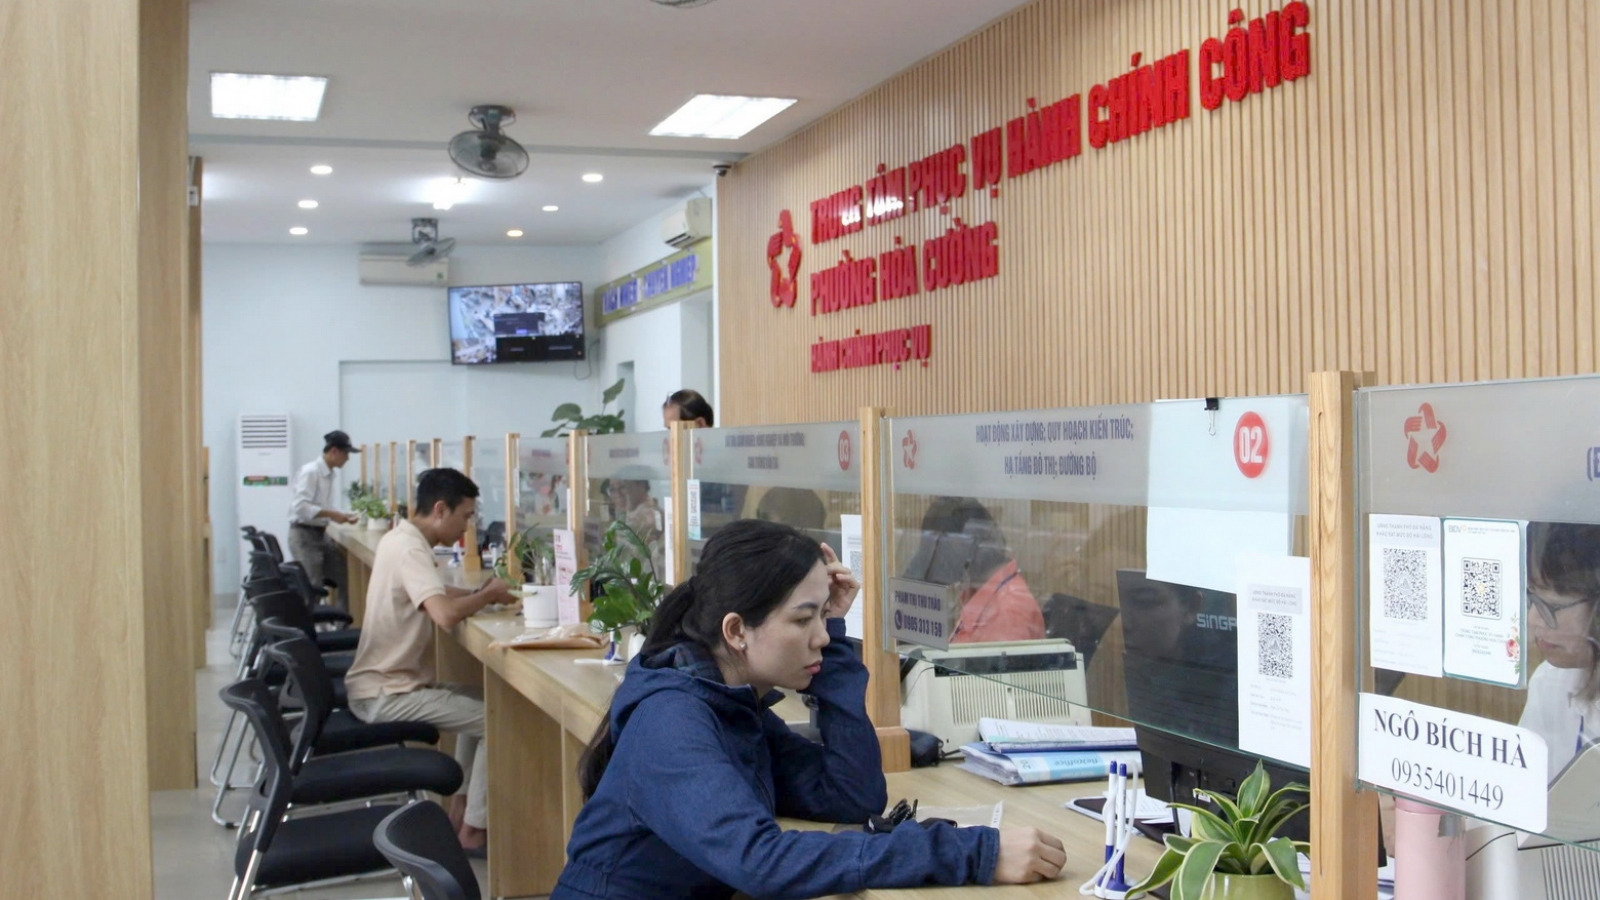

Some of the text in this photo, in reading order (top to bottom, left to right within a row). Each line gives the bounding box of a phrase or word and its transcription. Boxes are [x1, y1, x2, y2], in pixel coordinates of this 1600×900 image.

[810, 0, 1310, 245] TRUNG TÂM PHỤC VỤ HÀNH CHÍNH CÔNG
[810, 217, 999, 316] PHƯỜNG HÒA CƯỜNG
[975, 425, 992, 447] HOẠT
[992, 420, 1010, 447] ĐỘNG
[1010, 420, 1025, 443] XÂY
[1047, 421, 1062, 444] QUY
[1063, 420, 1088, 445] HOẠCH
[1089, 413, 1109, 441] KIẾN
[1110, 414, 1134, 441] TRÚC;
[1239, 425, 1263, 464] 02
[839, 438, 850, 463] 03
[1059, 451, 1084, 476] ĐƯỜNG
[1085, 451, 1097, 481] BỘ
[919, 617, 930, 635] 313
[931, 621, 943, 638] 159
[1374, 709, 1528, 769] NGÔ BÍCH HÀ
[1391, 757, 1504, 811] 0935401449
